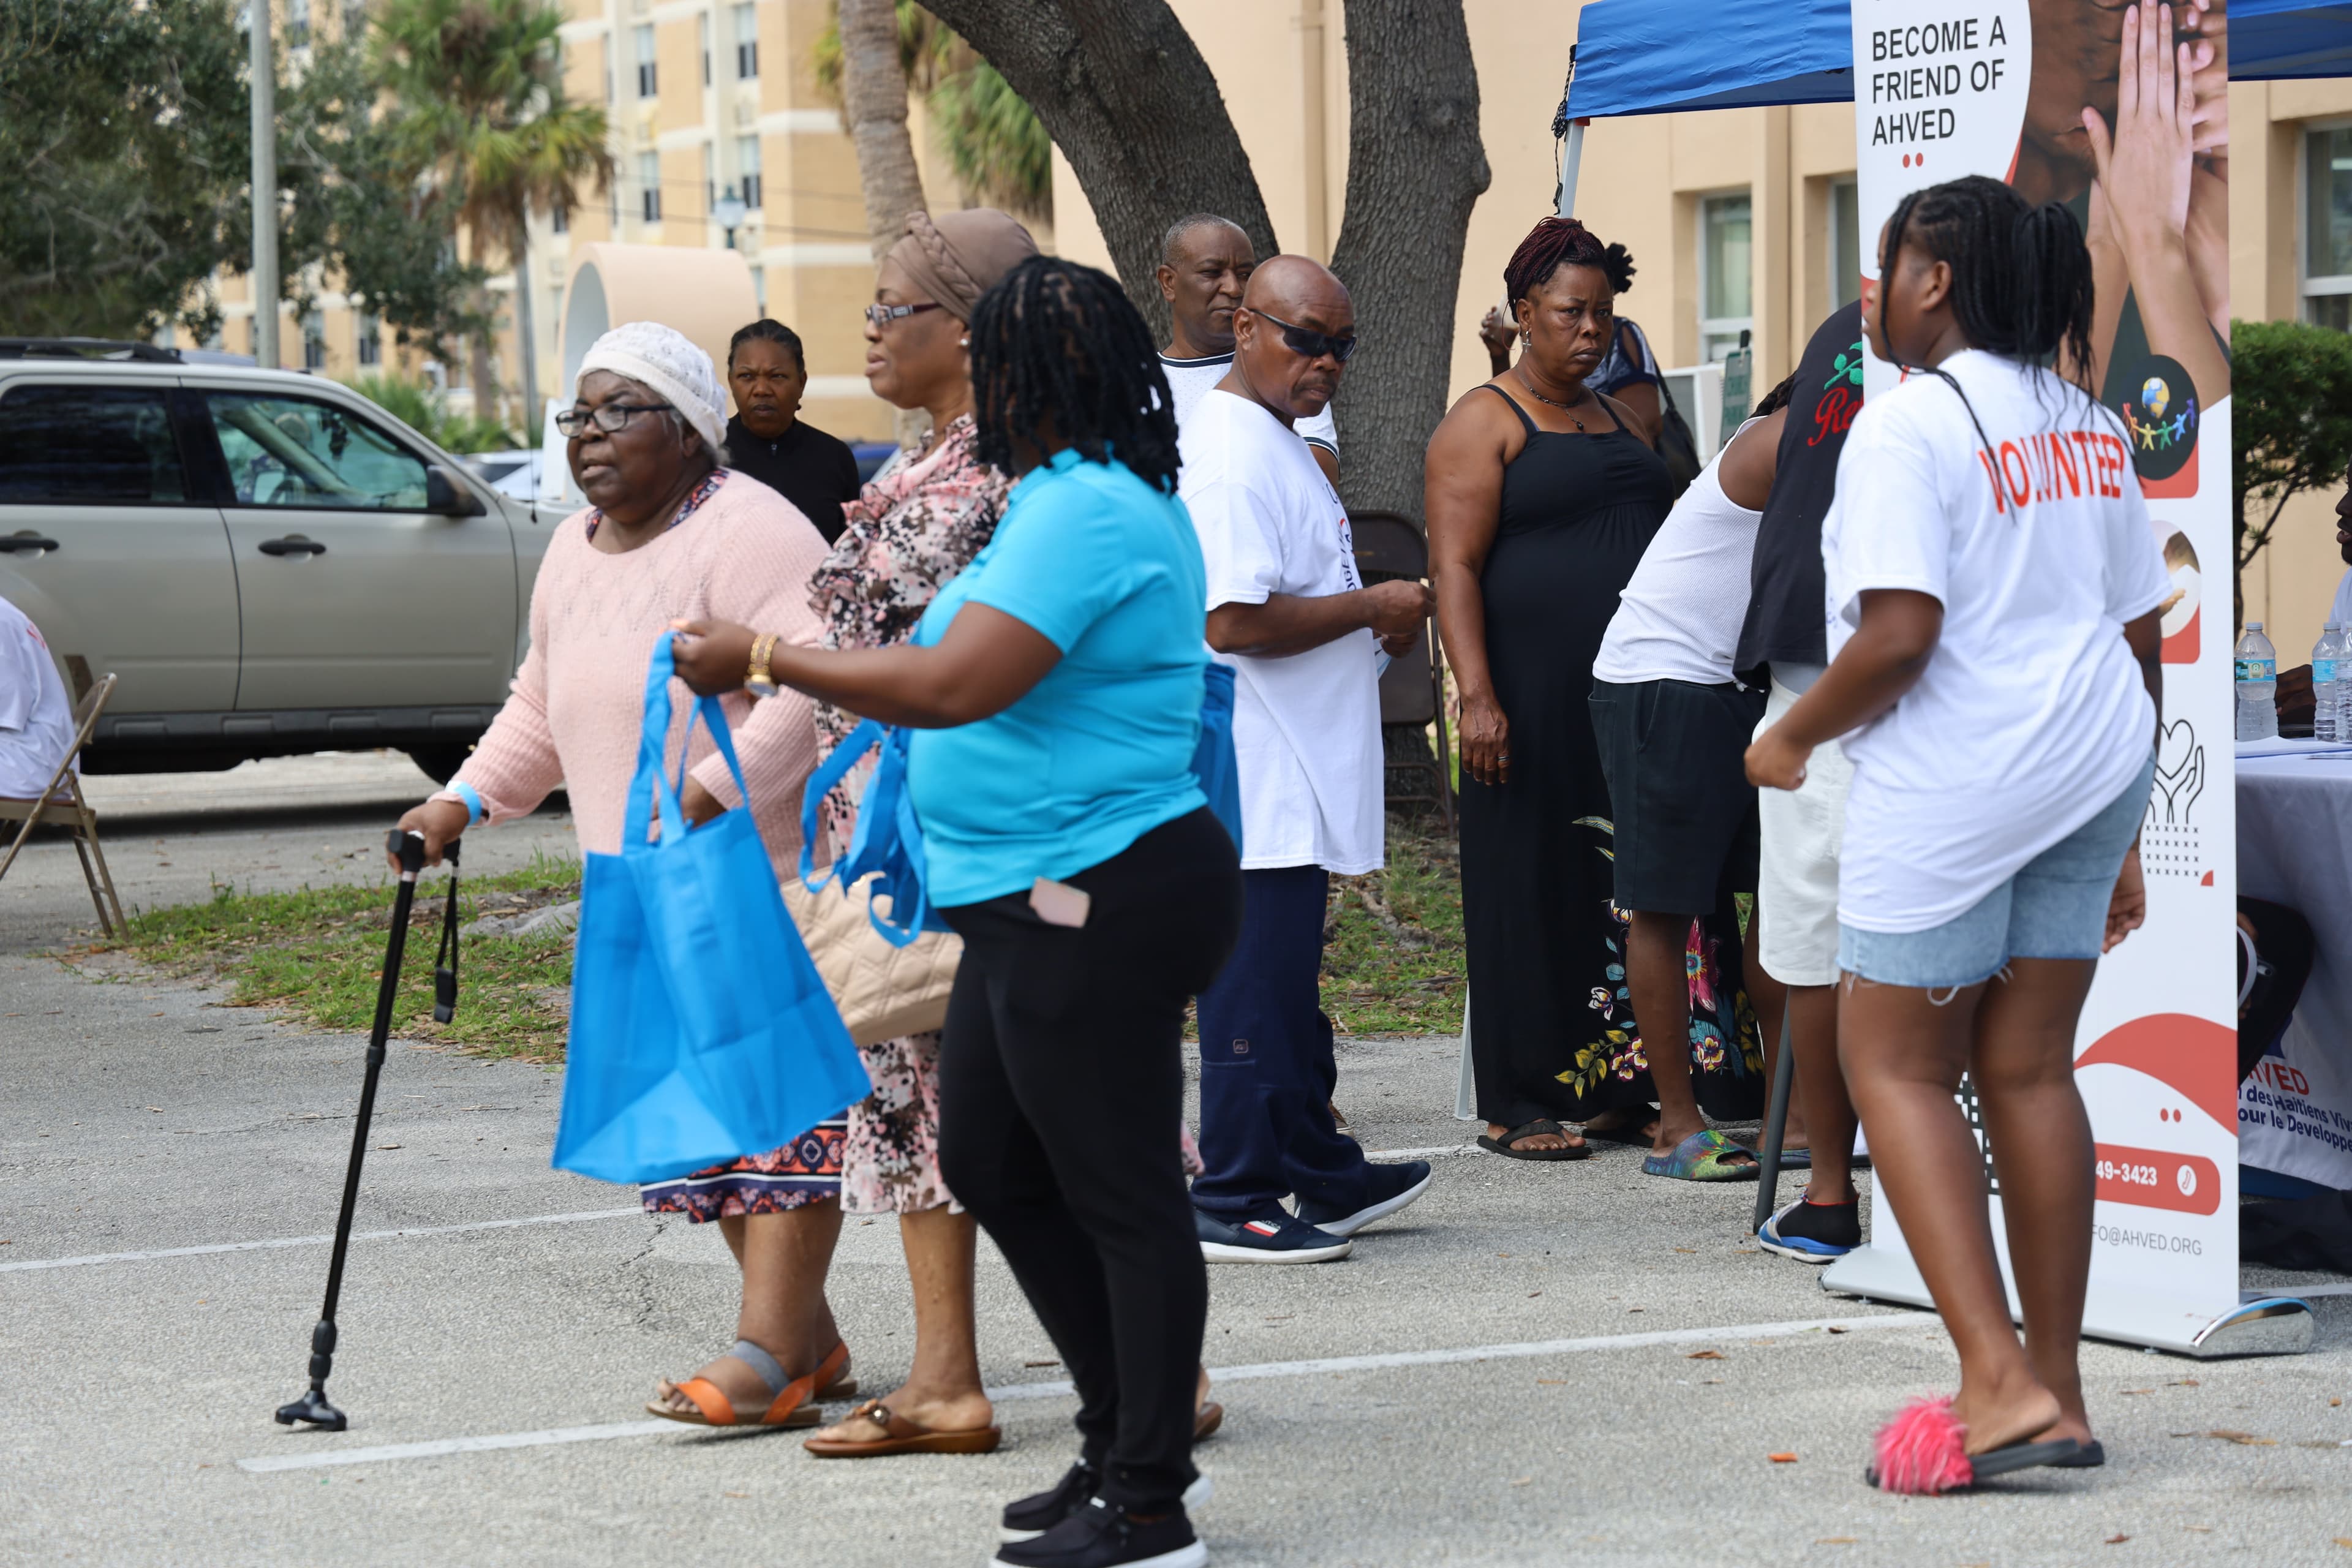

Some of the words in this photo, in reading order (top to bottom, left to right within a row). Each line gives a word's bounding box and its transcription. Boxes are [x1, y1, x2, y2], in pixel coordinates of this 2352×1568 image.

[1872, 18, 1978, 61] BECOME
[1989, 15, 2007, 47] A
[1873, 64, 1961, 104] FRIEND
[1970, 58, 2005, 92] OF
[1872, 108, 1955, 146] AHVED
[2237, 1108, 2266, 1125] our
[2270, 1110, 2284, 1129] le
[2246, 1085, 2273, 1106] des
[2273, 1094, 2329, 1123] Haitiens
[2328, 1110, 2352, 1133] Viv
[2095, 1160, 2157, 1186] 49-3423
